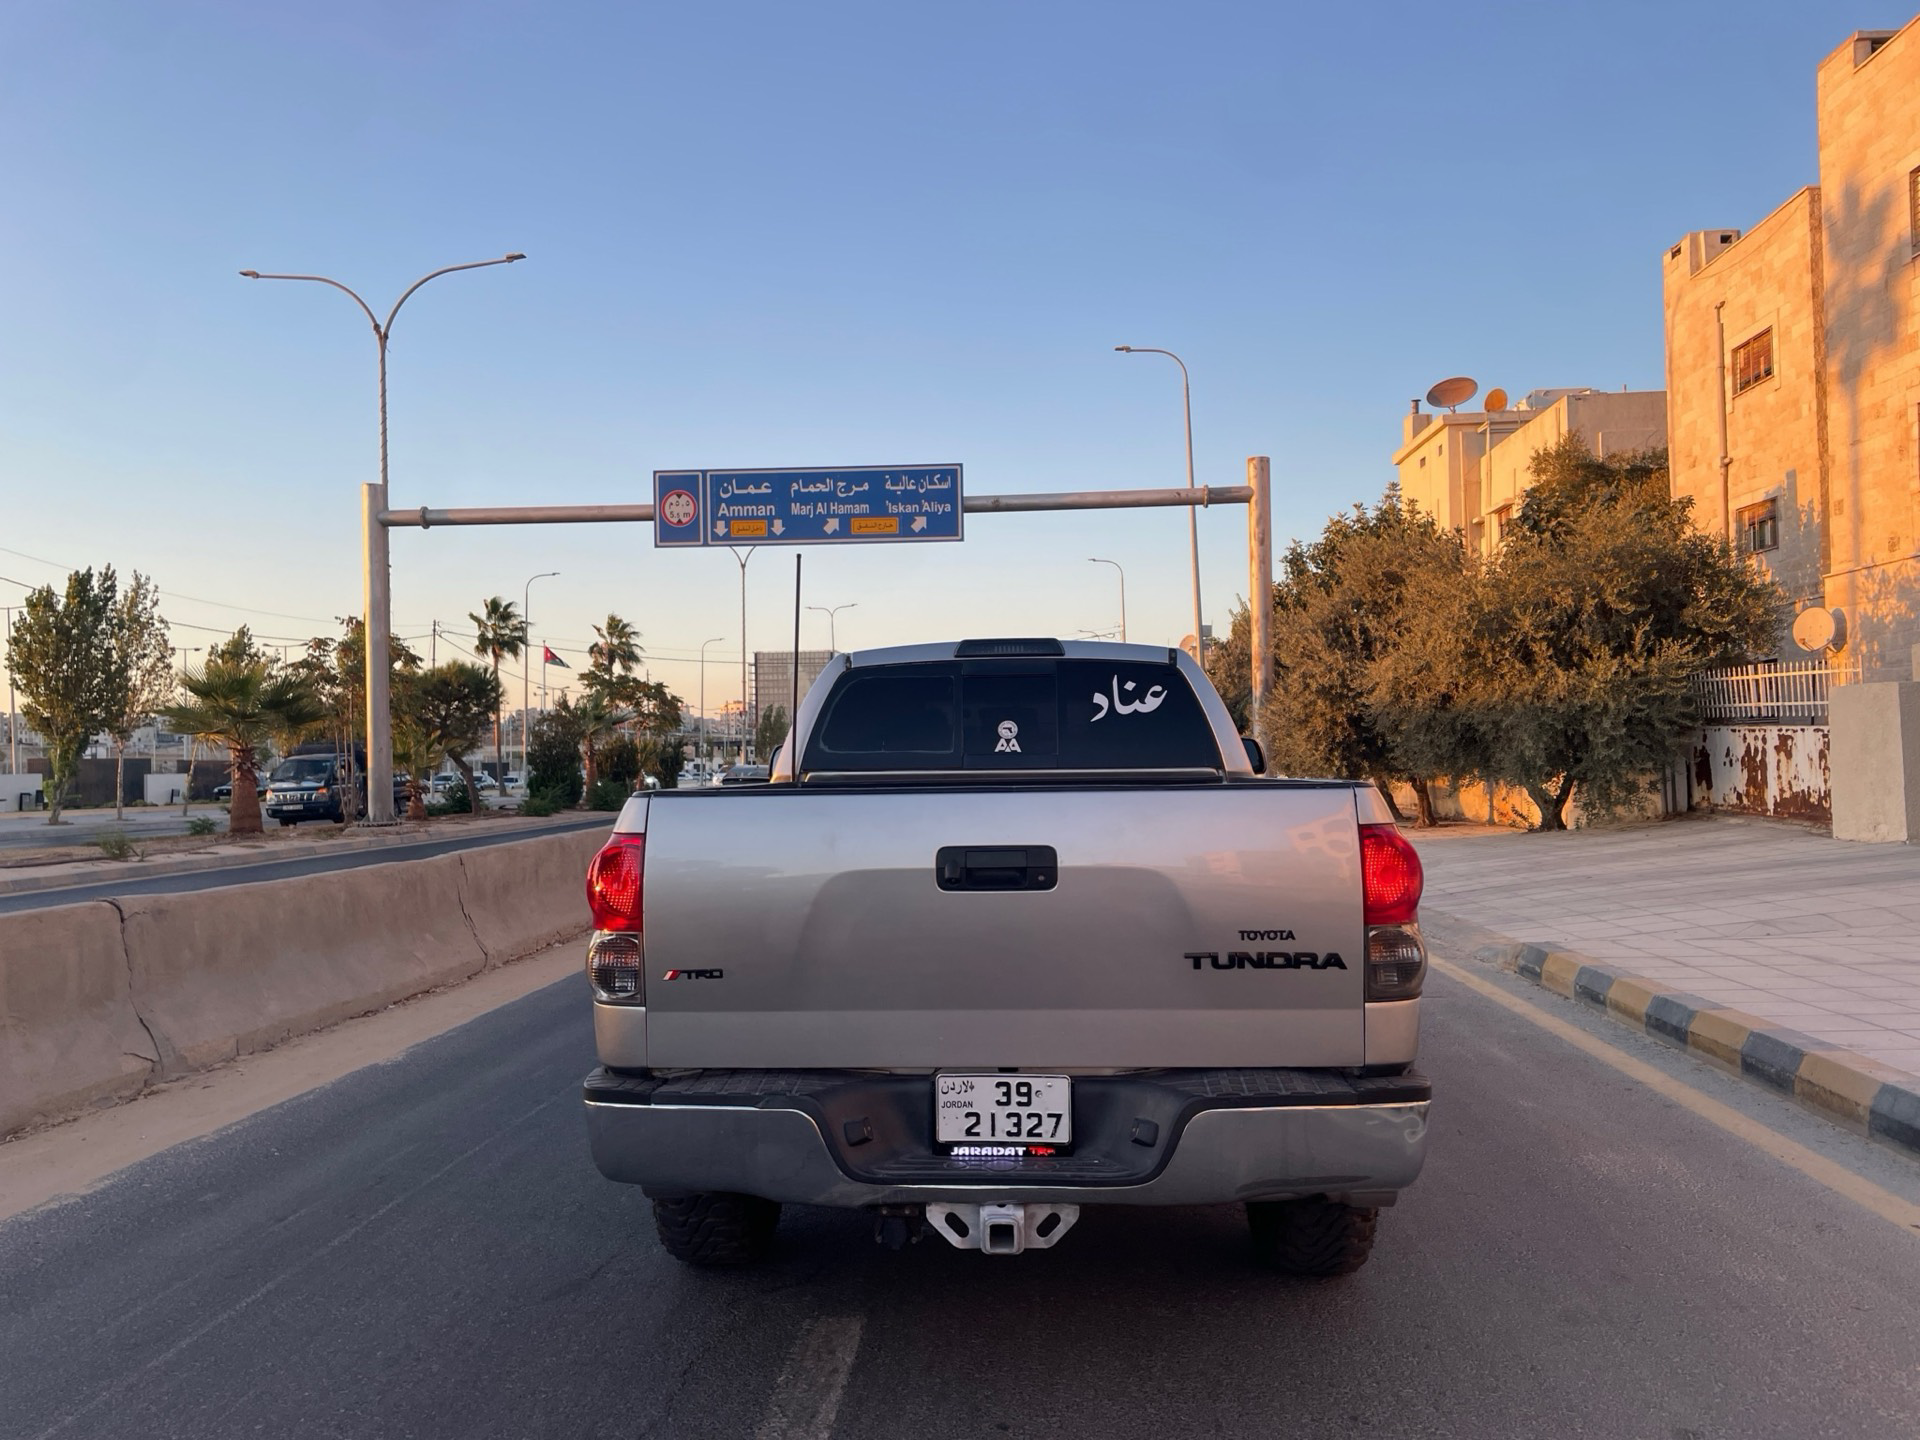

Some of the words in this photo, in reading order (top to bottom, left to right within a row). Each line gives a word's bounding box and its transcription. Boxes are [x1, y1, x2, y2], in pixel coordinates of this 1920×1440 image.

[719, 479, 773, 499] عمان
[791, 477, 834, 498] الحمام
[837, 481, 869, 498] مرج
[885, 474, 917, 495] عالية
[718, 503, 776, 517] Amman
[791, 502, 814, 518] Marj
[816, 501, 828, 515] Al
[830, 502, 870, 515] Hamam
[1090, 674, 1168, 723] عناد
[1238, 930, 1296, 941] TOYOTA
[1184, 952, 1348, 970] TUNDRA
[680, 968, 724, 980] TRD
[995, 1081, 1032, 1107] 39
[941, 1100, 974, 1109] JORDAN
[964, 1111, 1063, 1138] 21327
[950, 1146, 1027, 1157] JARADAT
